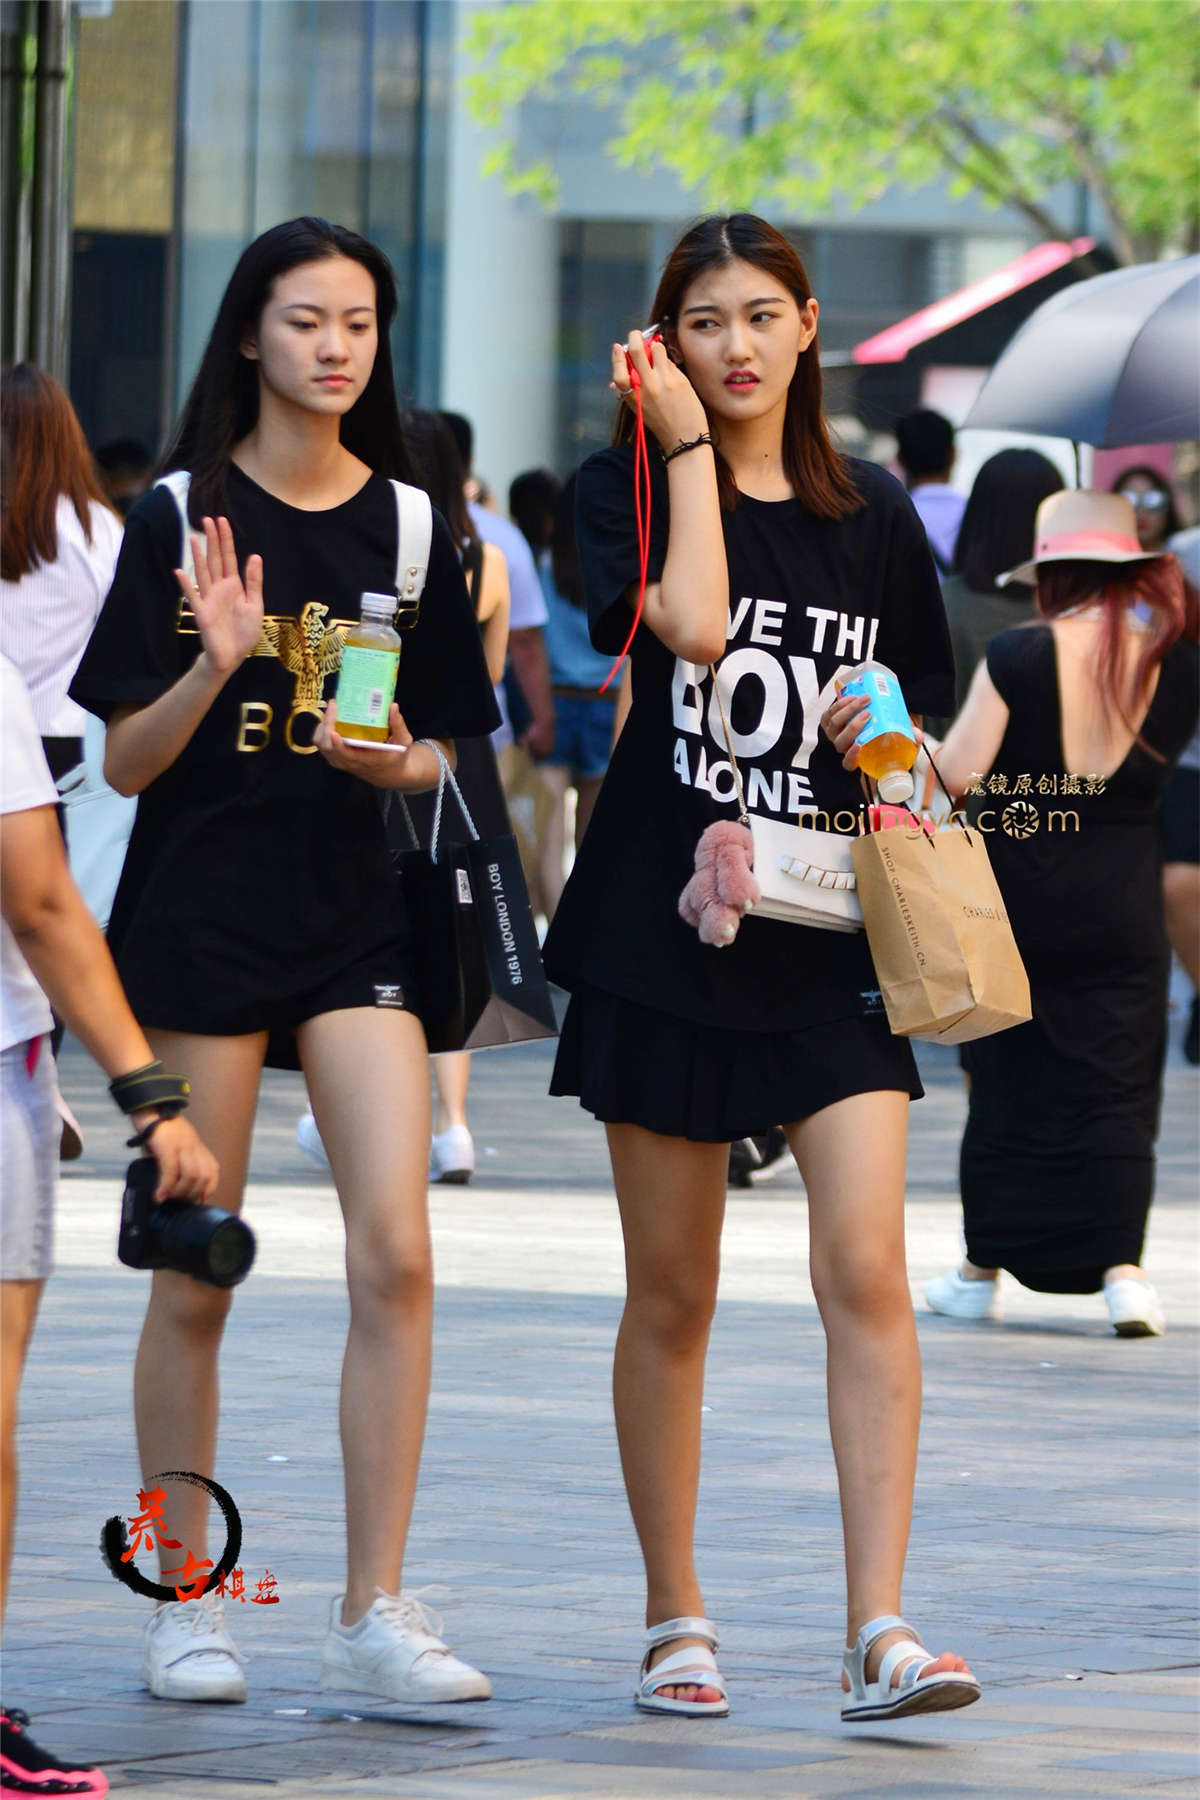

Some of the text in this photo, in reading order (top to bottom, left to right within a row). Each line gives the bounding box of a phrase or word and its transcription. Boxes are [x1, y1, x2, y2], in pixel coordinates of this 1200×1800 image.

[726, 597, 787, 646] VE
[237, 702, 324, 755] BO
[671, 647, 855, 770] BOY
[673, 738, 819, 814] ALONE
[488, 863, 523, 985] BOY LONDON 1976
